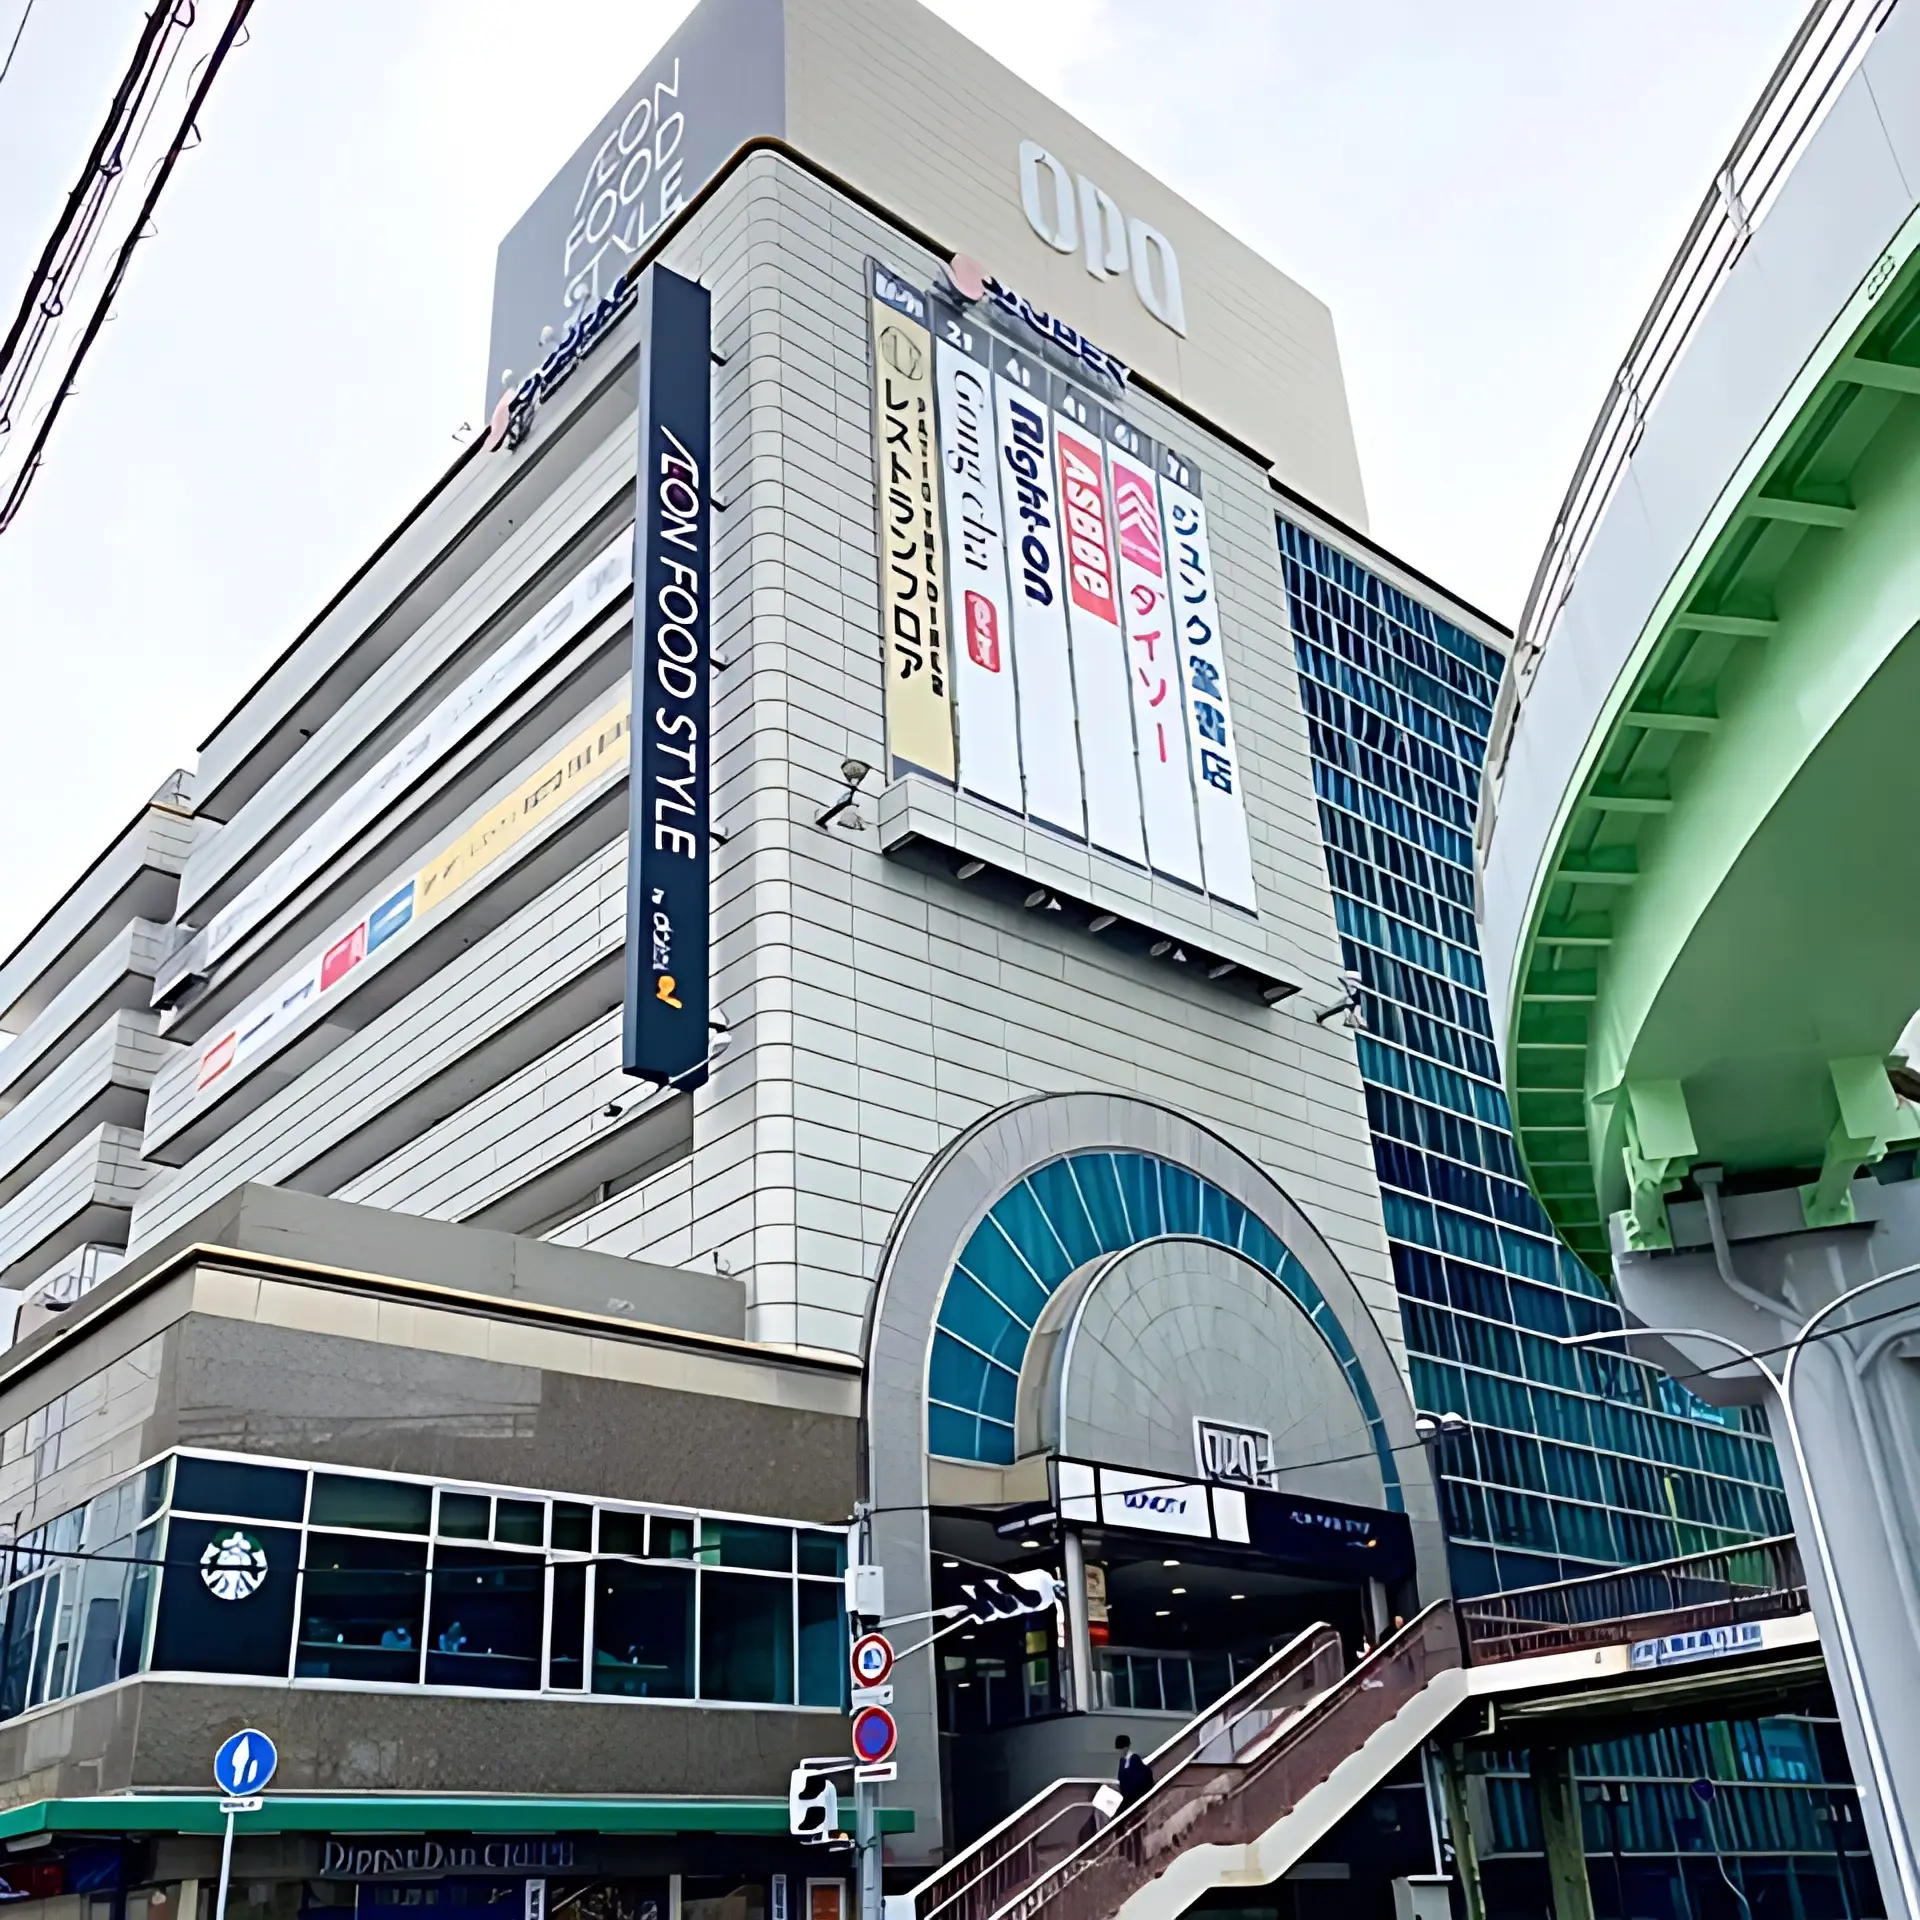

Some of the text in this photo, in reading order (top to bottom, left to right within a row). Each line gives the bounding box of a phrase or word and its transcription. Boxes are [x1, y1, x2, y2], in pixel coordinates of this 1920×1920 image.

[563, 111, 685, 278] FOOD
[656, 555, 700, 699] FOOD
[1130, 583, 1168, 764] ダイソー
[655, 707, 697, 860] STYLE
